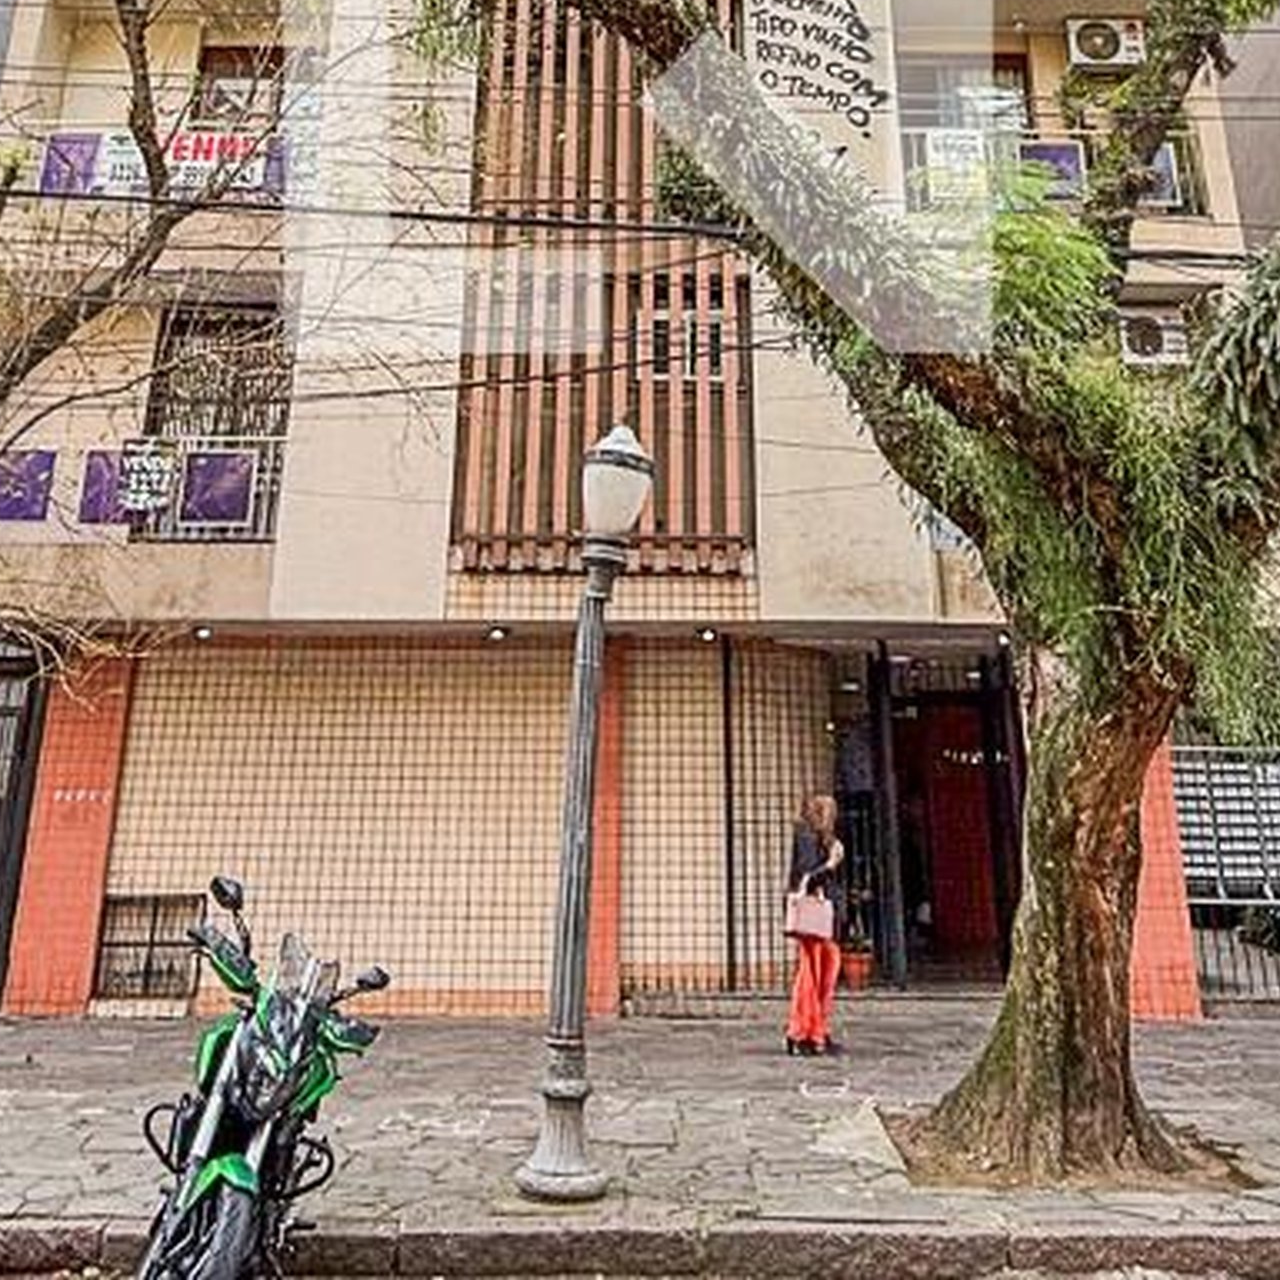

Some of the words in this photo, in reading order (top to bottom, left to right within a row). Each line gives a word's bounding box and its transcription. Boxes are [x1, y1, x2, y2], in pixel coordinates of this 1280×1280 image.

[750, 10, 797, 37] TIPO
[802, 23, 873, 63] VINHO
[760, 69, 778, 89] O
[826, 62, 888, 108] COM
